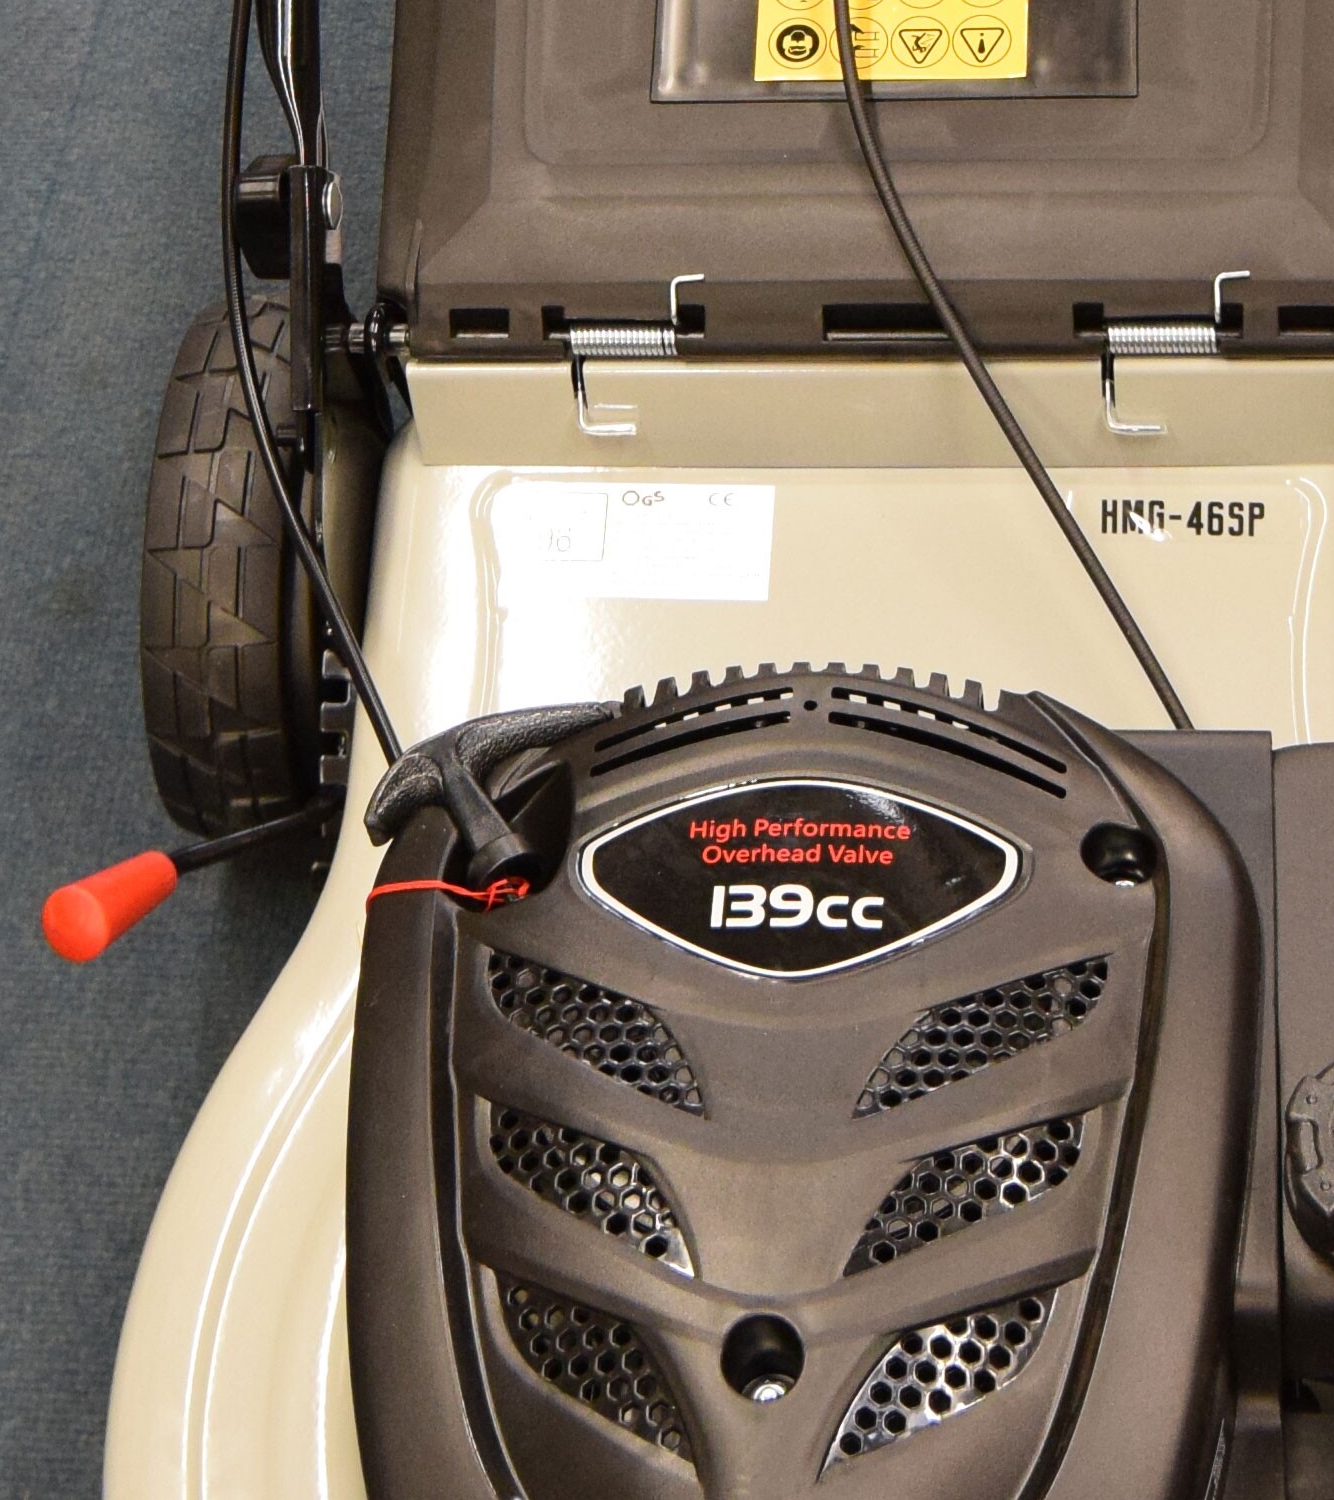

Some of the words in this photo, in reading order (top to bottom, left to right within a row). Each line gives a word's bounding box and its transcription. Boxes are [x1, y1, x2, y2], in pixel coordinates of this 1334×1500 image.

[1100, 498, 1266, 538] HMG-46SP
[689, 818, 748, 844] High
[753, 817, 913, 841] Performance
[701, 843, 821, 865] Overhead
[827, 843, 895, 866] Valve
[709, 883, 885, 931] 139cc
